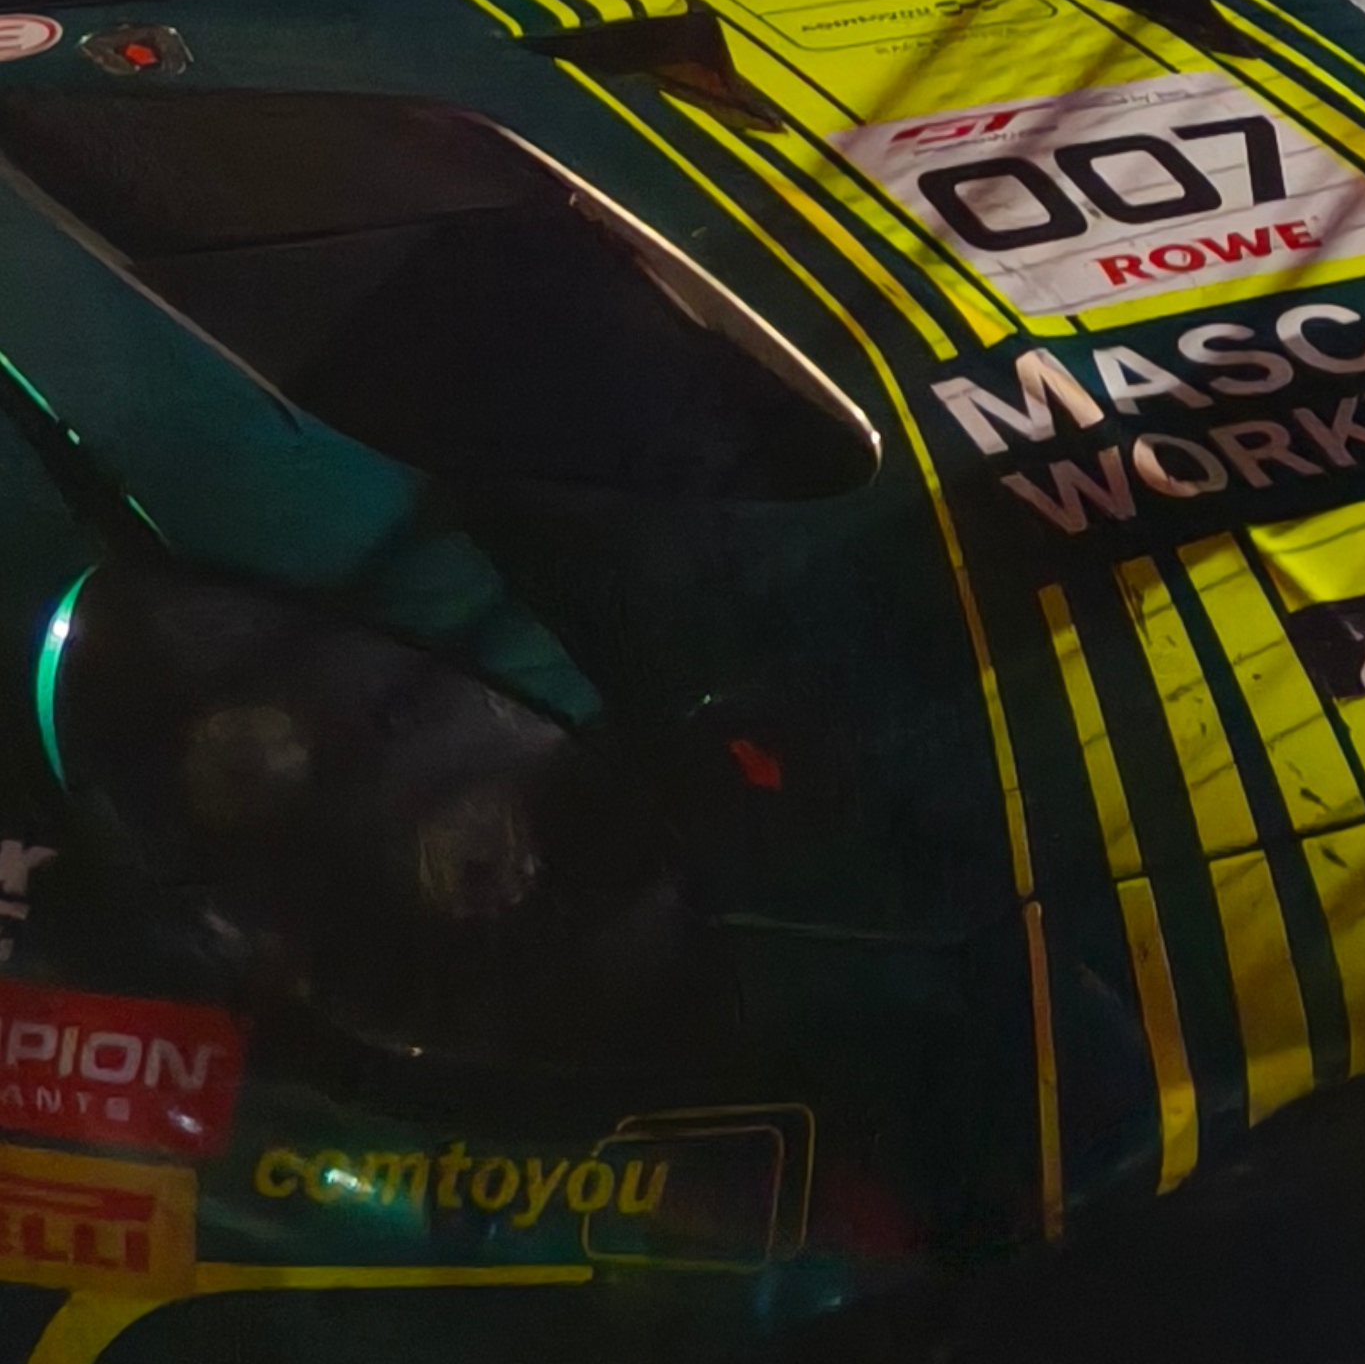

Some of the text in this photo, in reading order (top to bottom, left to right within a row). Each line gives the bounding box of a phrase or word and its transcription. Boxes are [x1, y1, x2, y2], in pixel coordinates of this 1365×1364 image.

[917, 115, 1287, 252] 007
[1094, 218, 1326, 287] ROWE
[0, 1019, 215, 1093] PION
[254, 1139, 669, 1228] comtoyou
